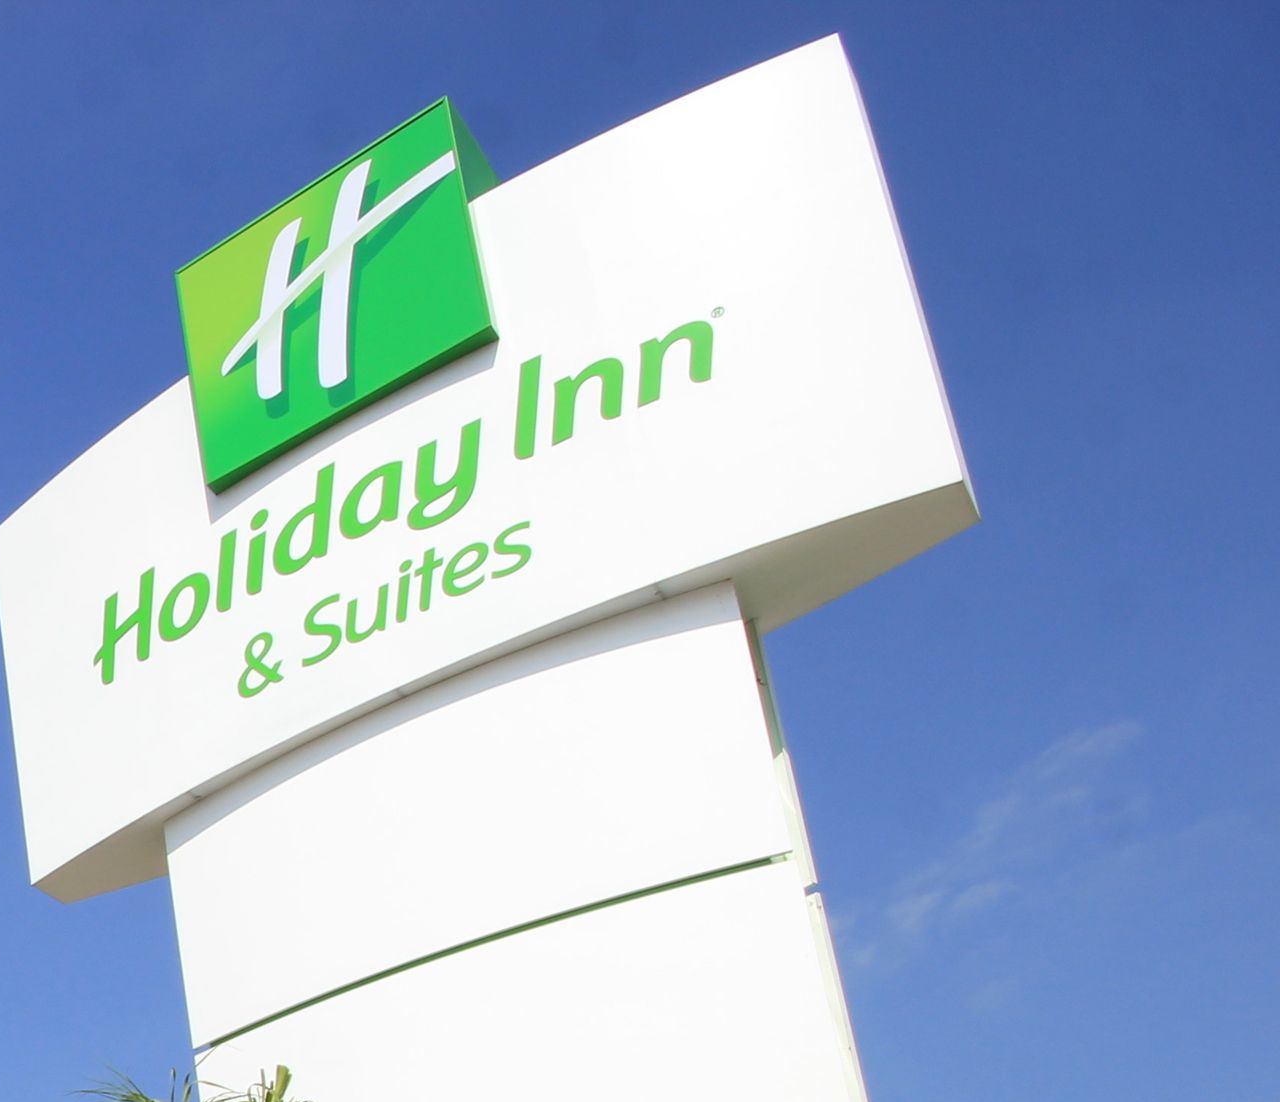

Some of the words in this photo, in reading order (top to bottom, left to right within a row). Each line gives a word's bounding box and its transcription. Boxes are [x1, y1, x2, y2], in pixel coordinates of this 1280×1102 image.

[94, 418, 481, 684] Holiday
[237, 631, 284, 698] &
[302, 521, 532, 667] Suites
